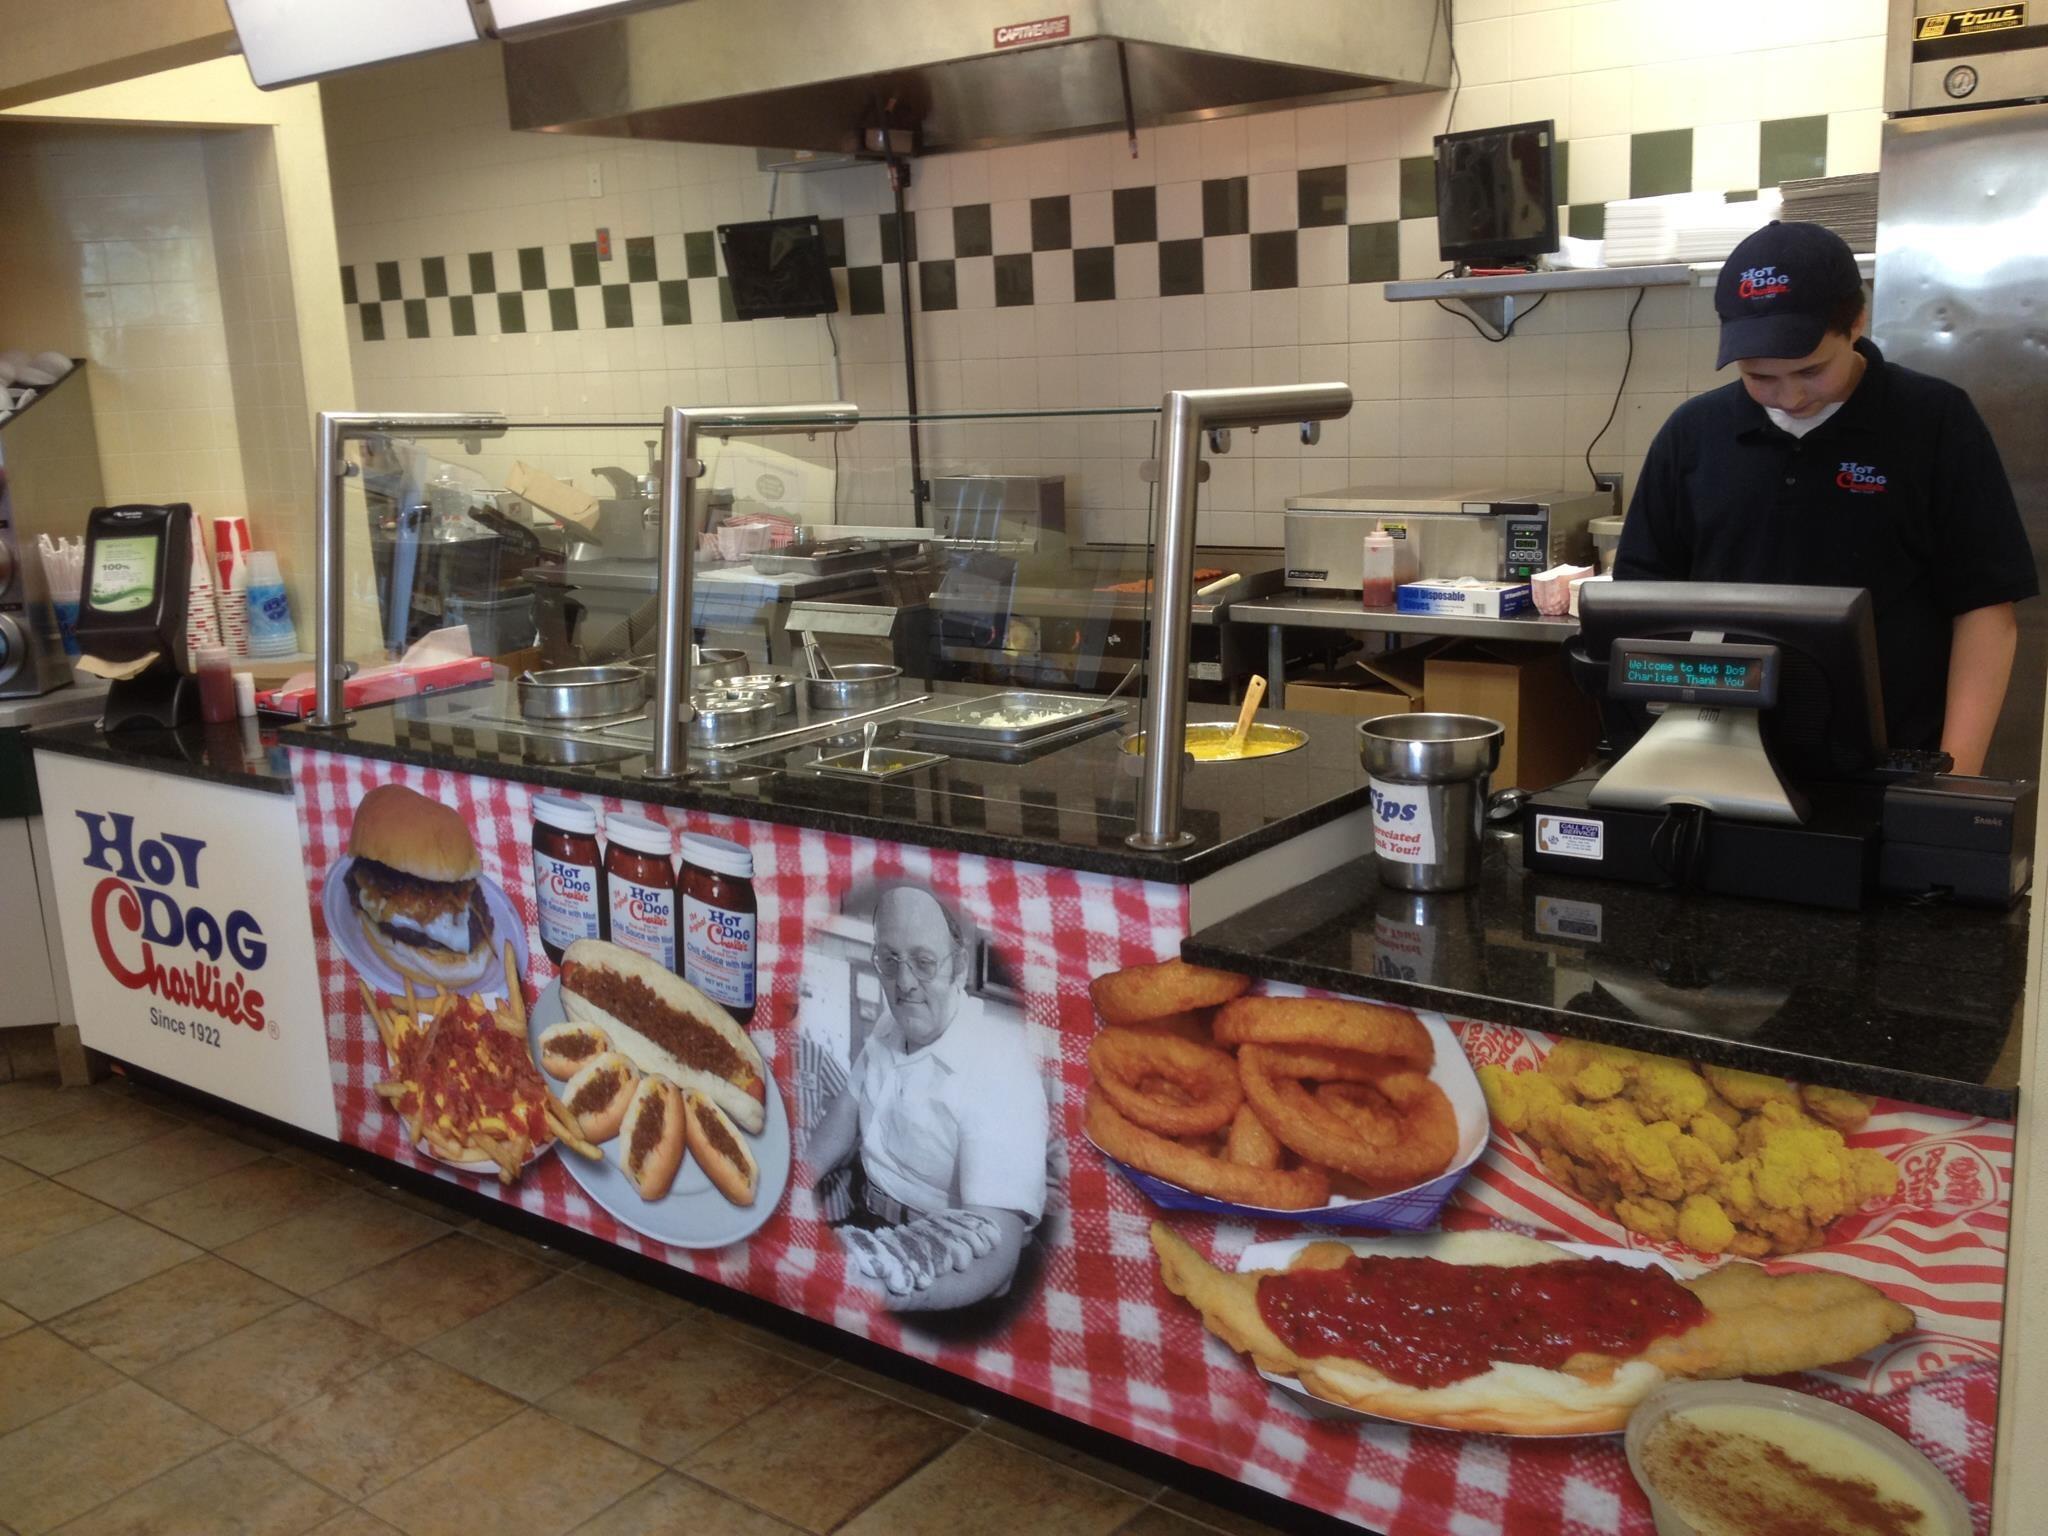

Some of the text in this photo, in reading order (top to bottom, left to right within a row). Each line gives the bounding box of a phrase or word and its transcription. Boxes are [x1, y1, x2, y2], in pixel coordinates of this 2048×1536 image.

[1953, 9, 2020, 27] true
[102, 563, 131, 571] 100%
[1421, 590, 1466, 602] Disposable
[1629, 660, 1746, 675] Welcome to Hot Dog
[1628, 671, 1745, 687] Charlies Thank You
[1390, 843, 1421, 856] You!!
[91, 877, 266, 1032] Charlie's
[150, 1007, 222, 1048] Since 1922
